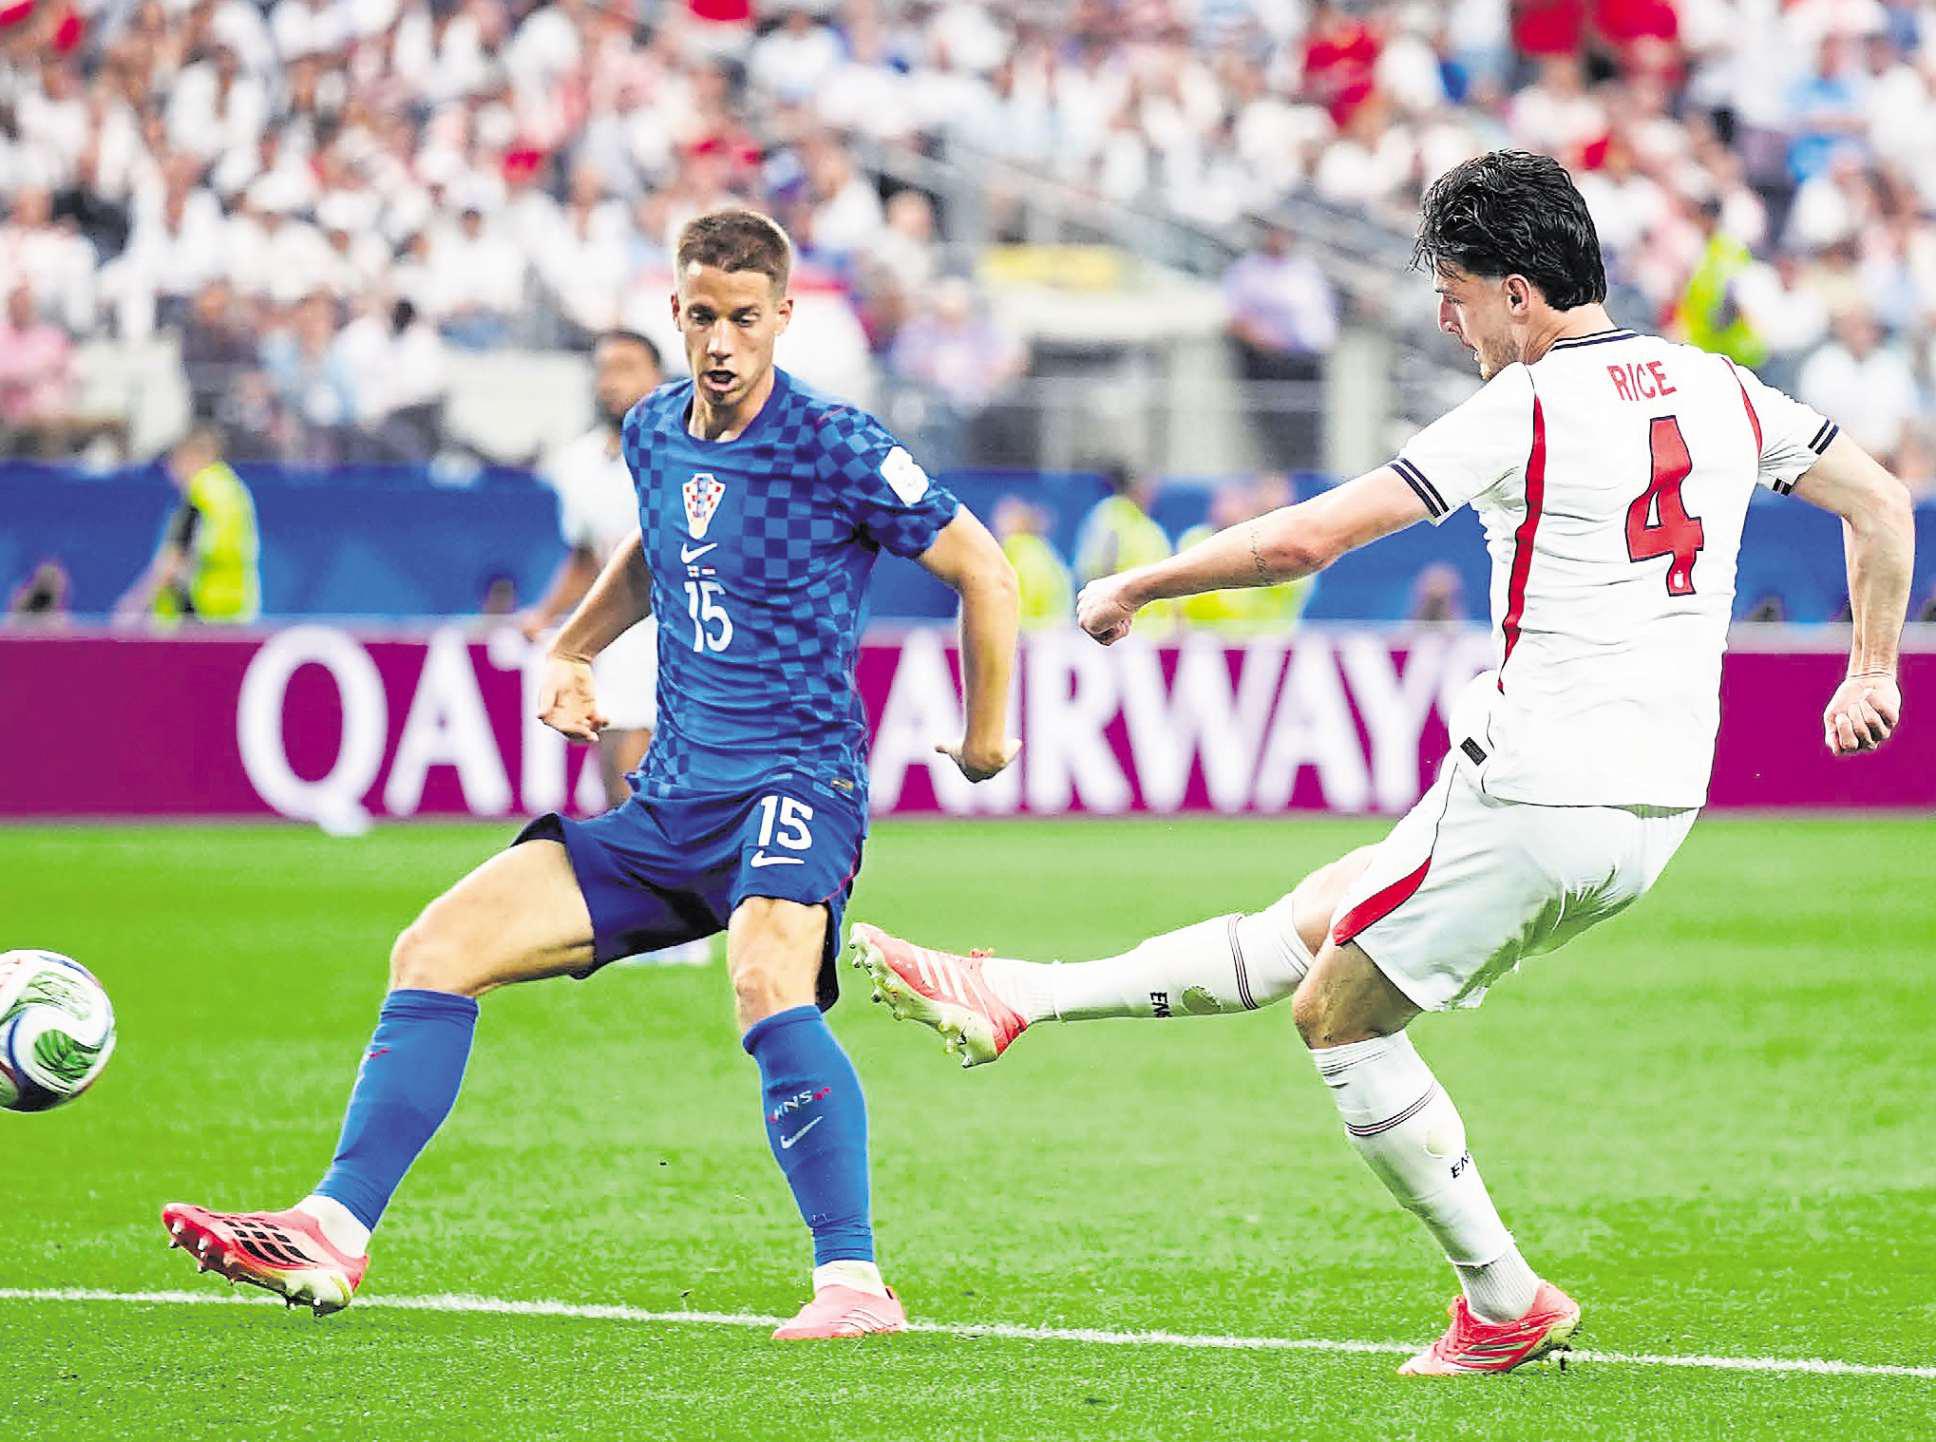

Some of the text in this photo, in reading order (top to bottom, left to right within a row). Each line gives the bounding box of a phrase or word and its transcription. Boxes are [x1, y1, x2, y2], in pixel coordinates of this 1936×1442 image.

[1606, 360, 1677, 401] RICE
[1624, 414, 1704, 597] 4
[684, 580, 733, 653] 15
[236, 624, 608, 837] QAT
[758, 795, 814, 850] 15
